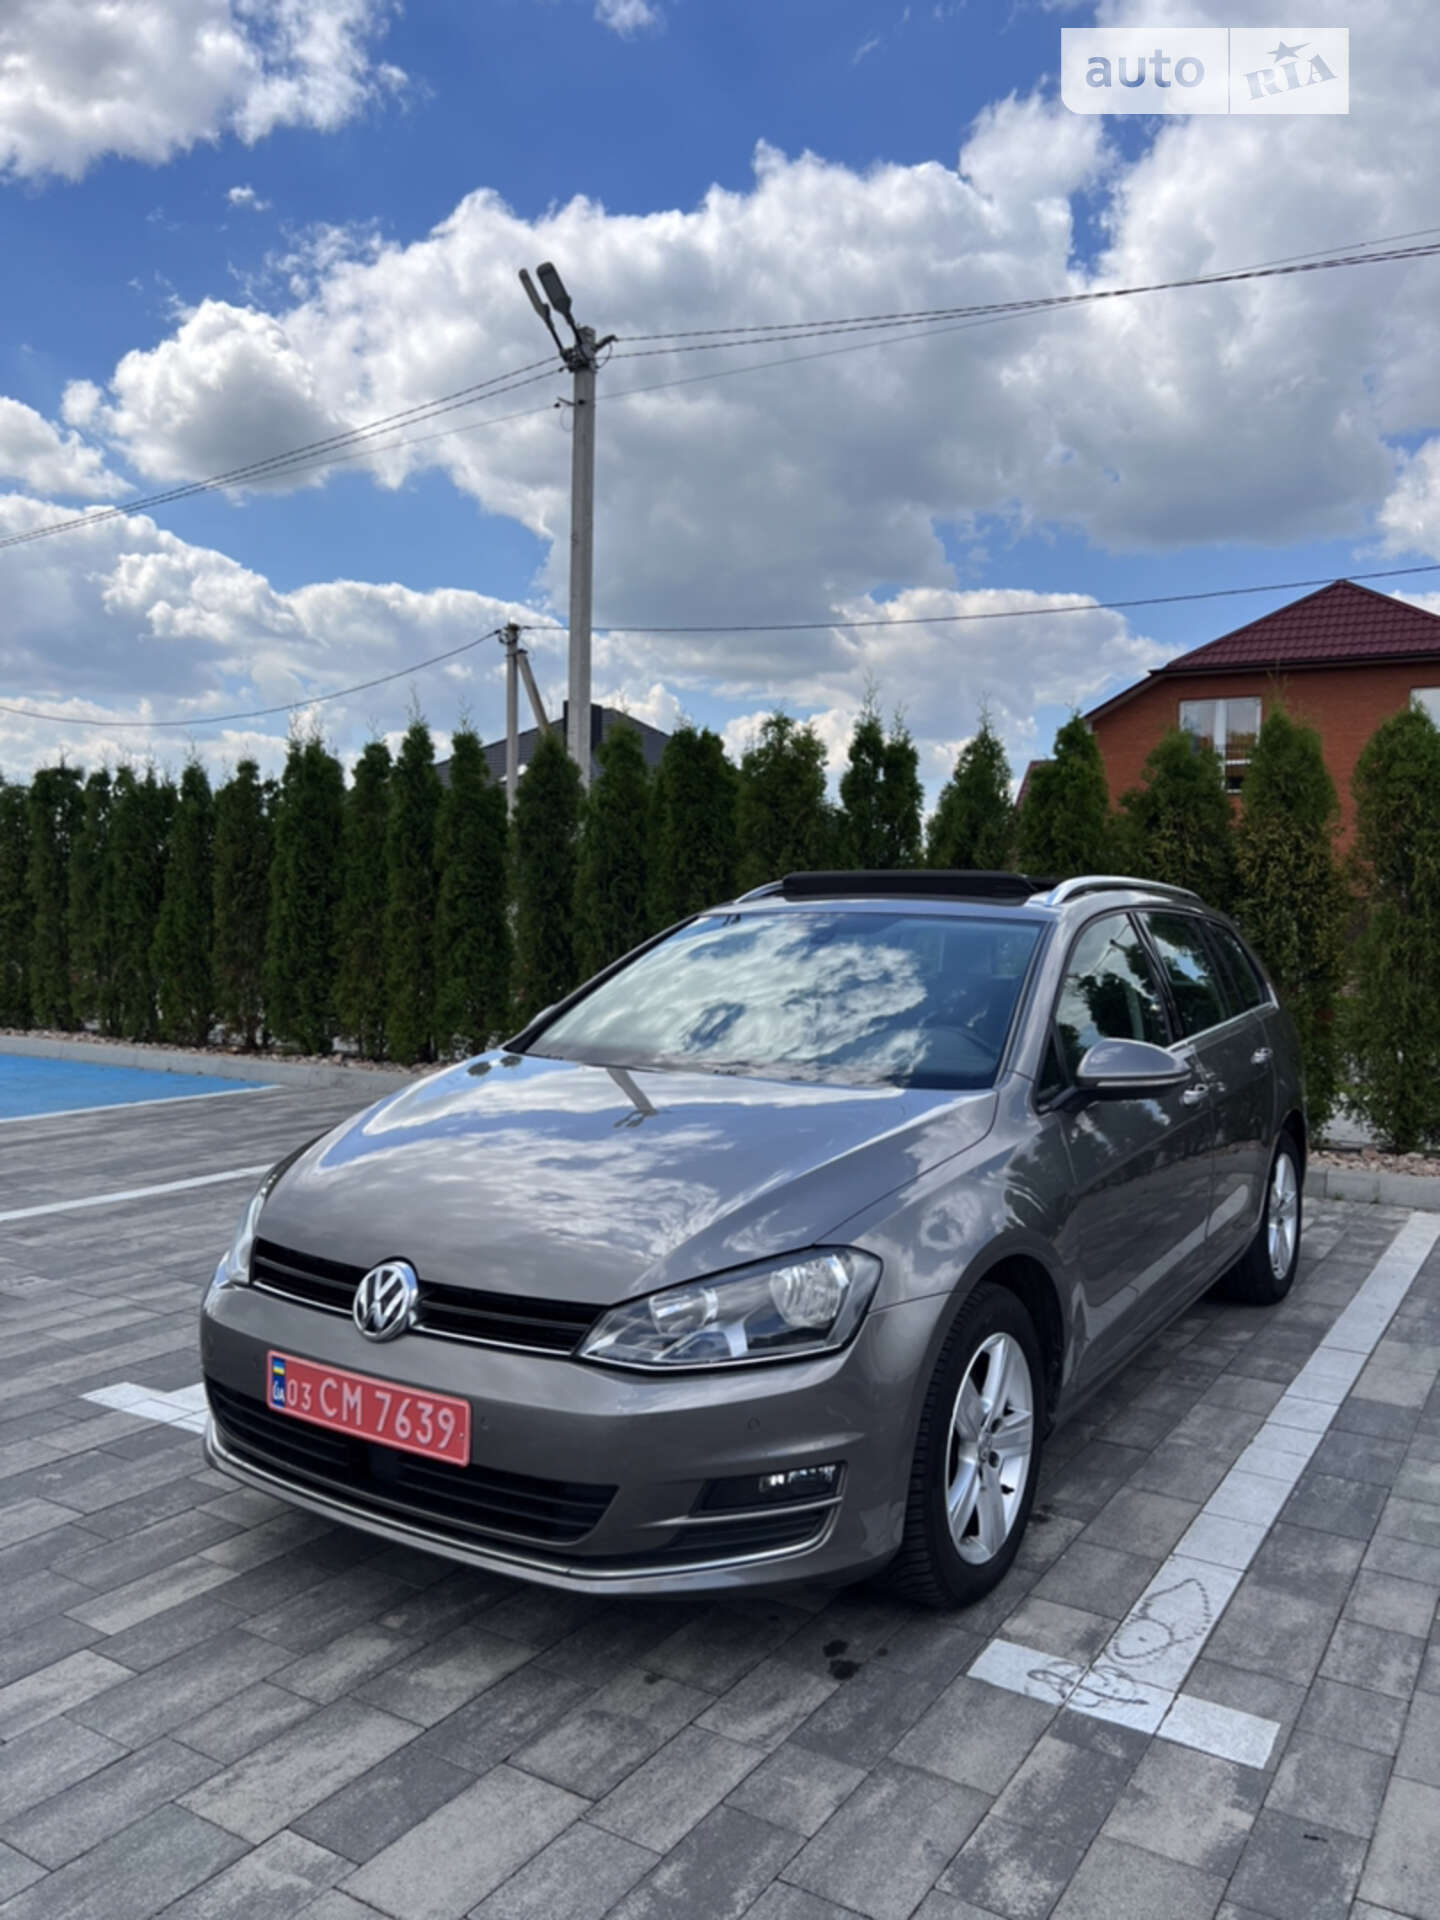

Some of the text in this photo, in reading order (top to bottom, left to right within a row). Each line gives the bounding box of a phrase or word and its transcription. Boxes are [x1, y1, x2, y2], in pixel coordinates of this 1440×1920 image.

[286, 1377, 456, 1449] 03 CM 7639
